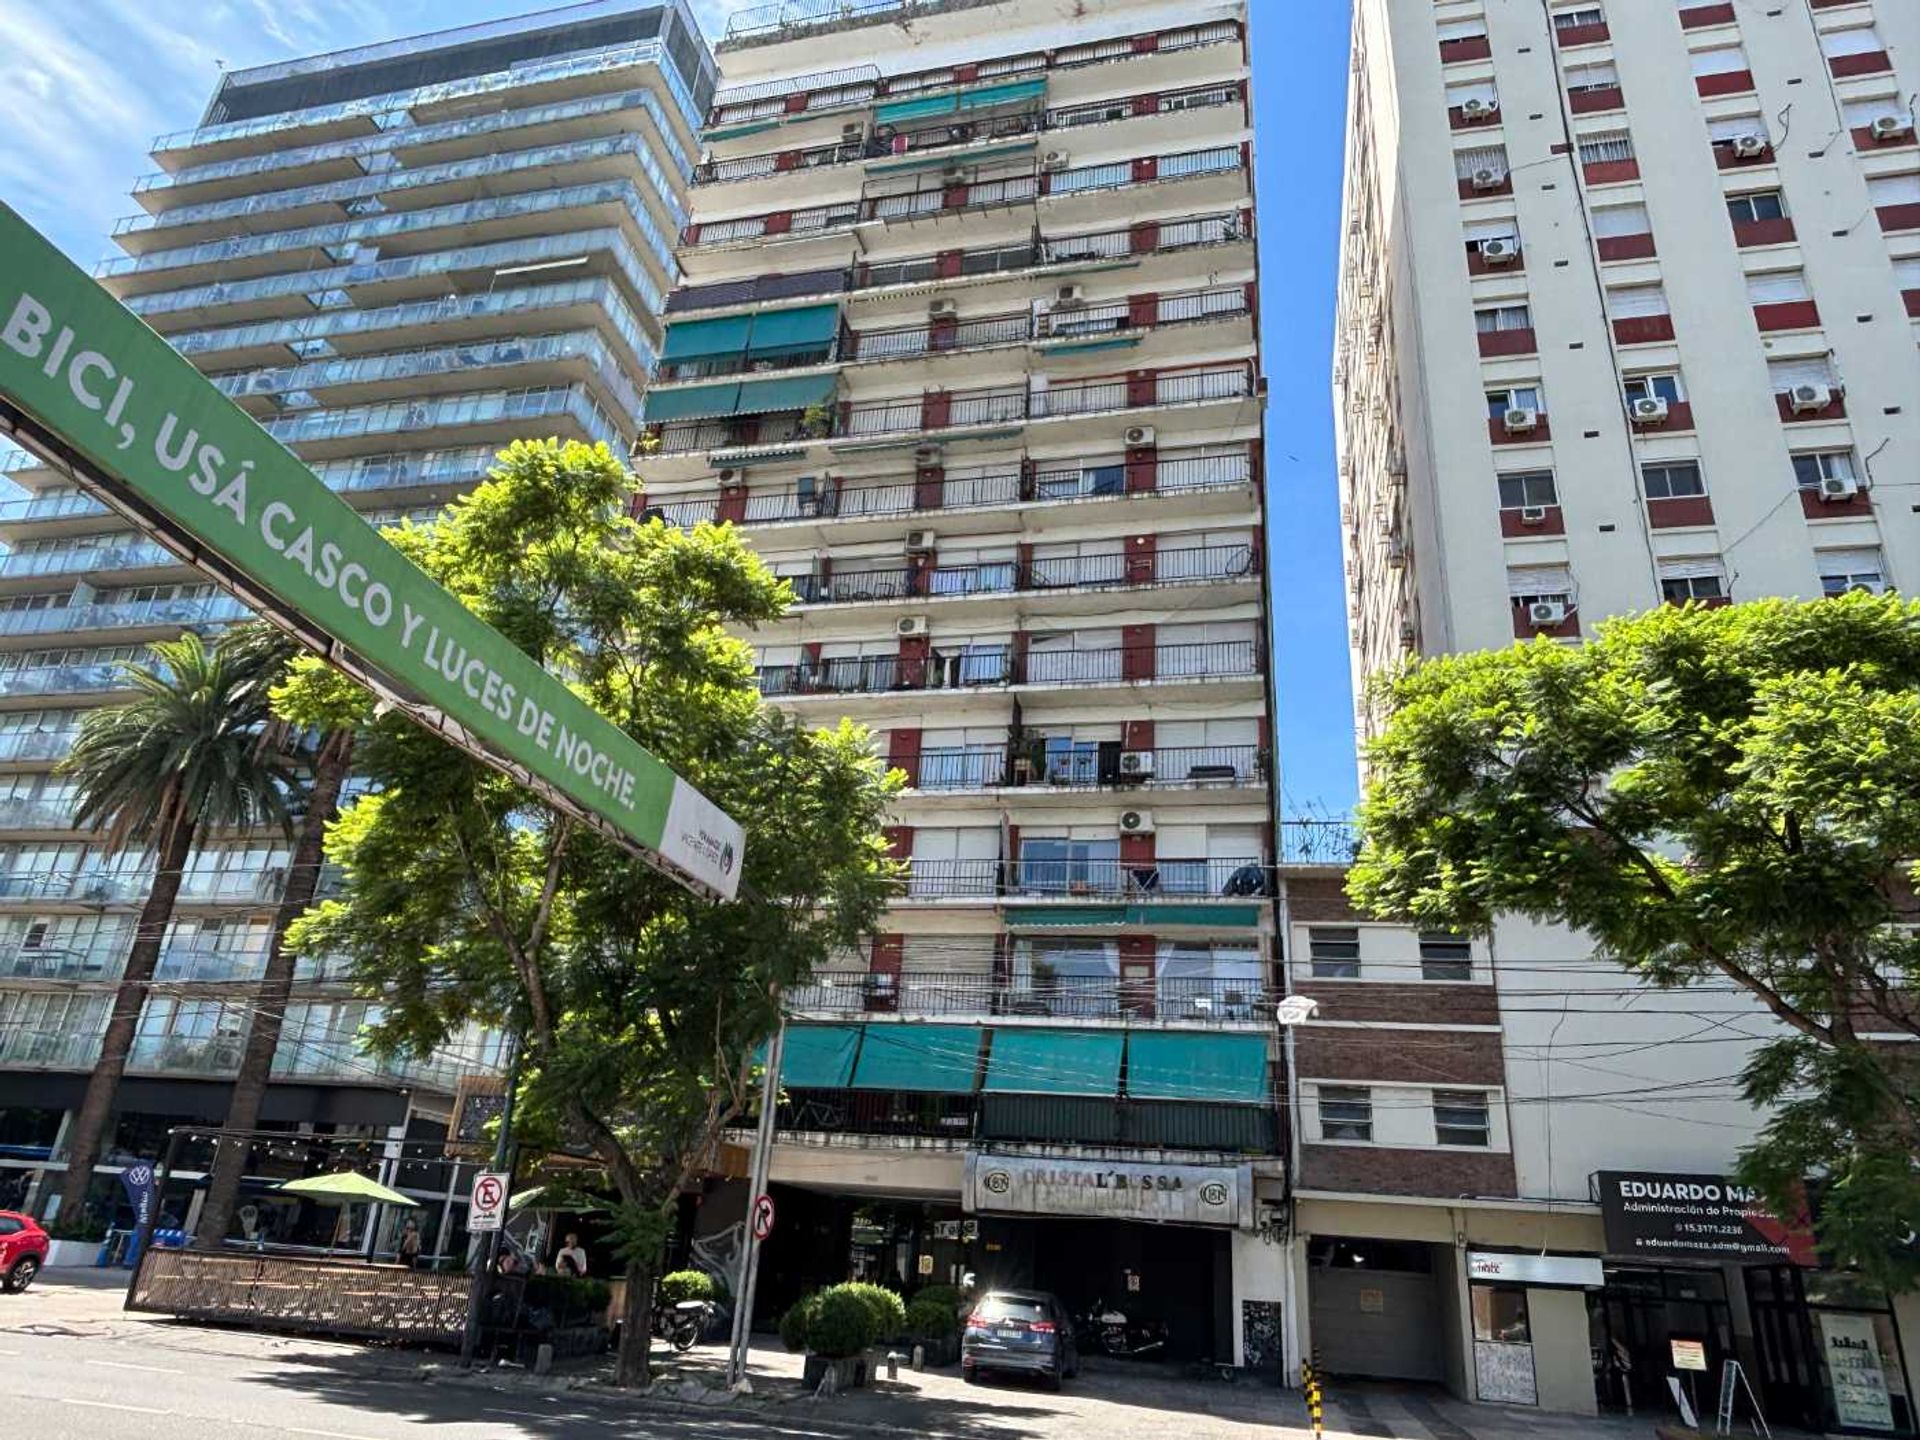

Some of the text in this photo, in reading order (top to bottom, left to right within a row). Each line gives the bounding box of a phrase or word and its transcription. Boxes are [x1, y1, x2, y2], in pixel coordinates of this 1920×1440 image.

[1, 293, 636, 811] BICI, USÁ CASCO Y LUCES DE NOCHE.
[1619, 1181, 1768, 1204] EDUARDO MA
[1623, 1202, 1703, 1215] Administración
